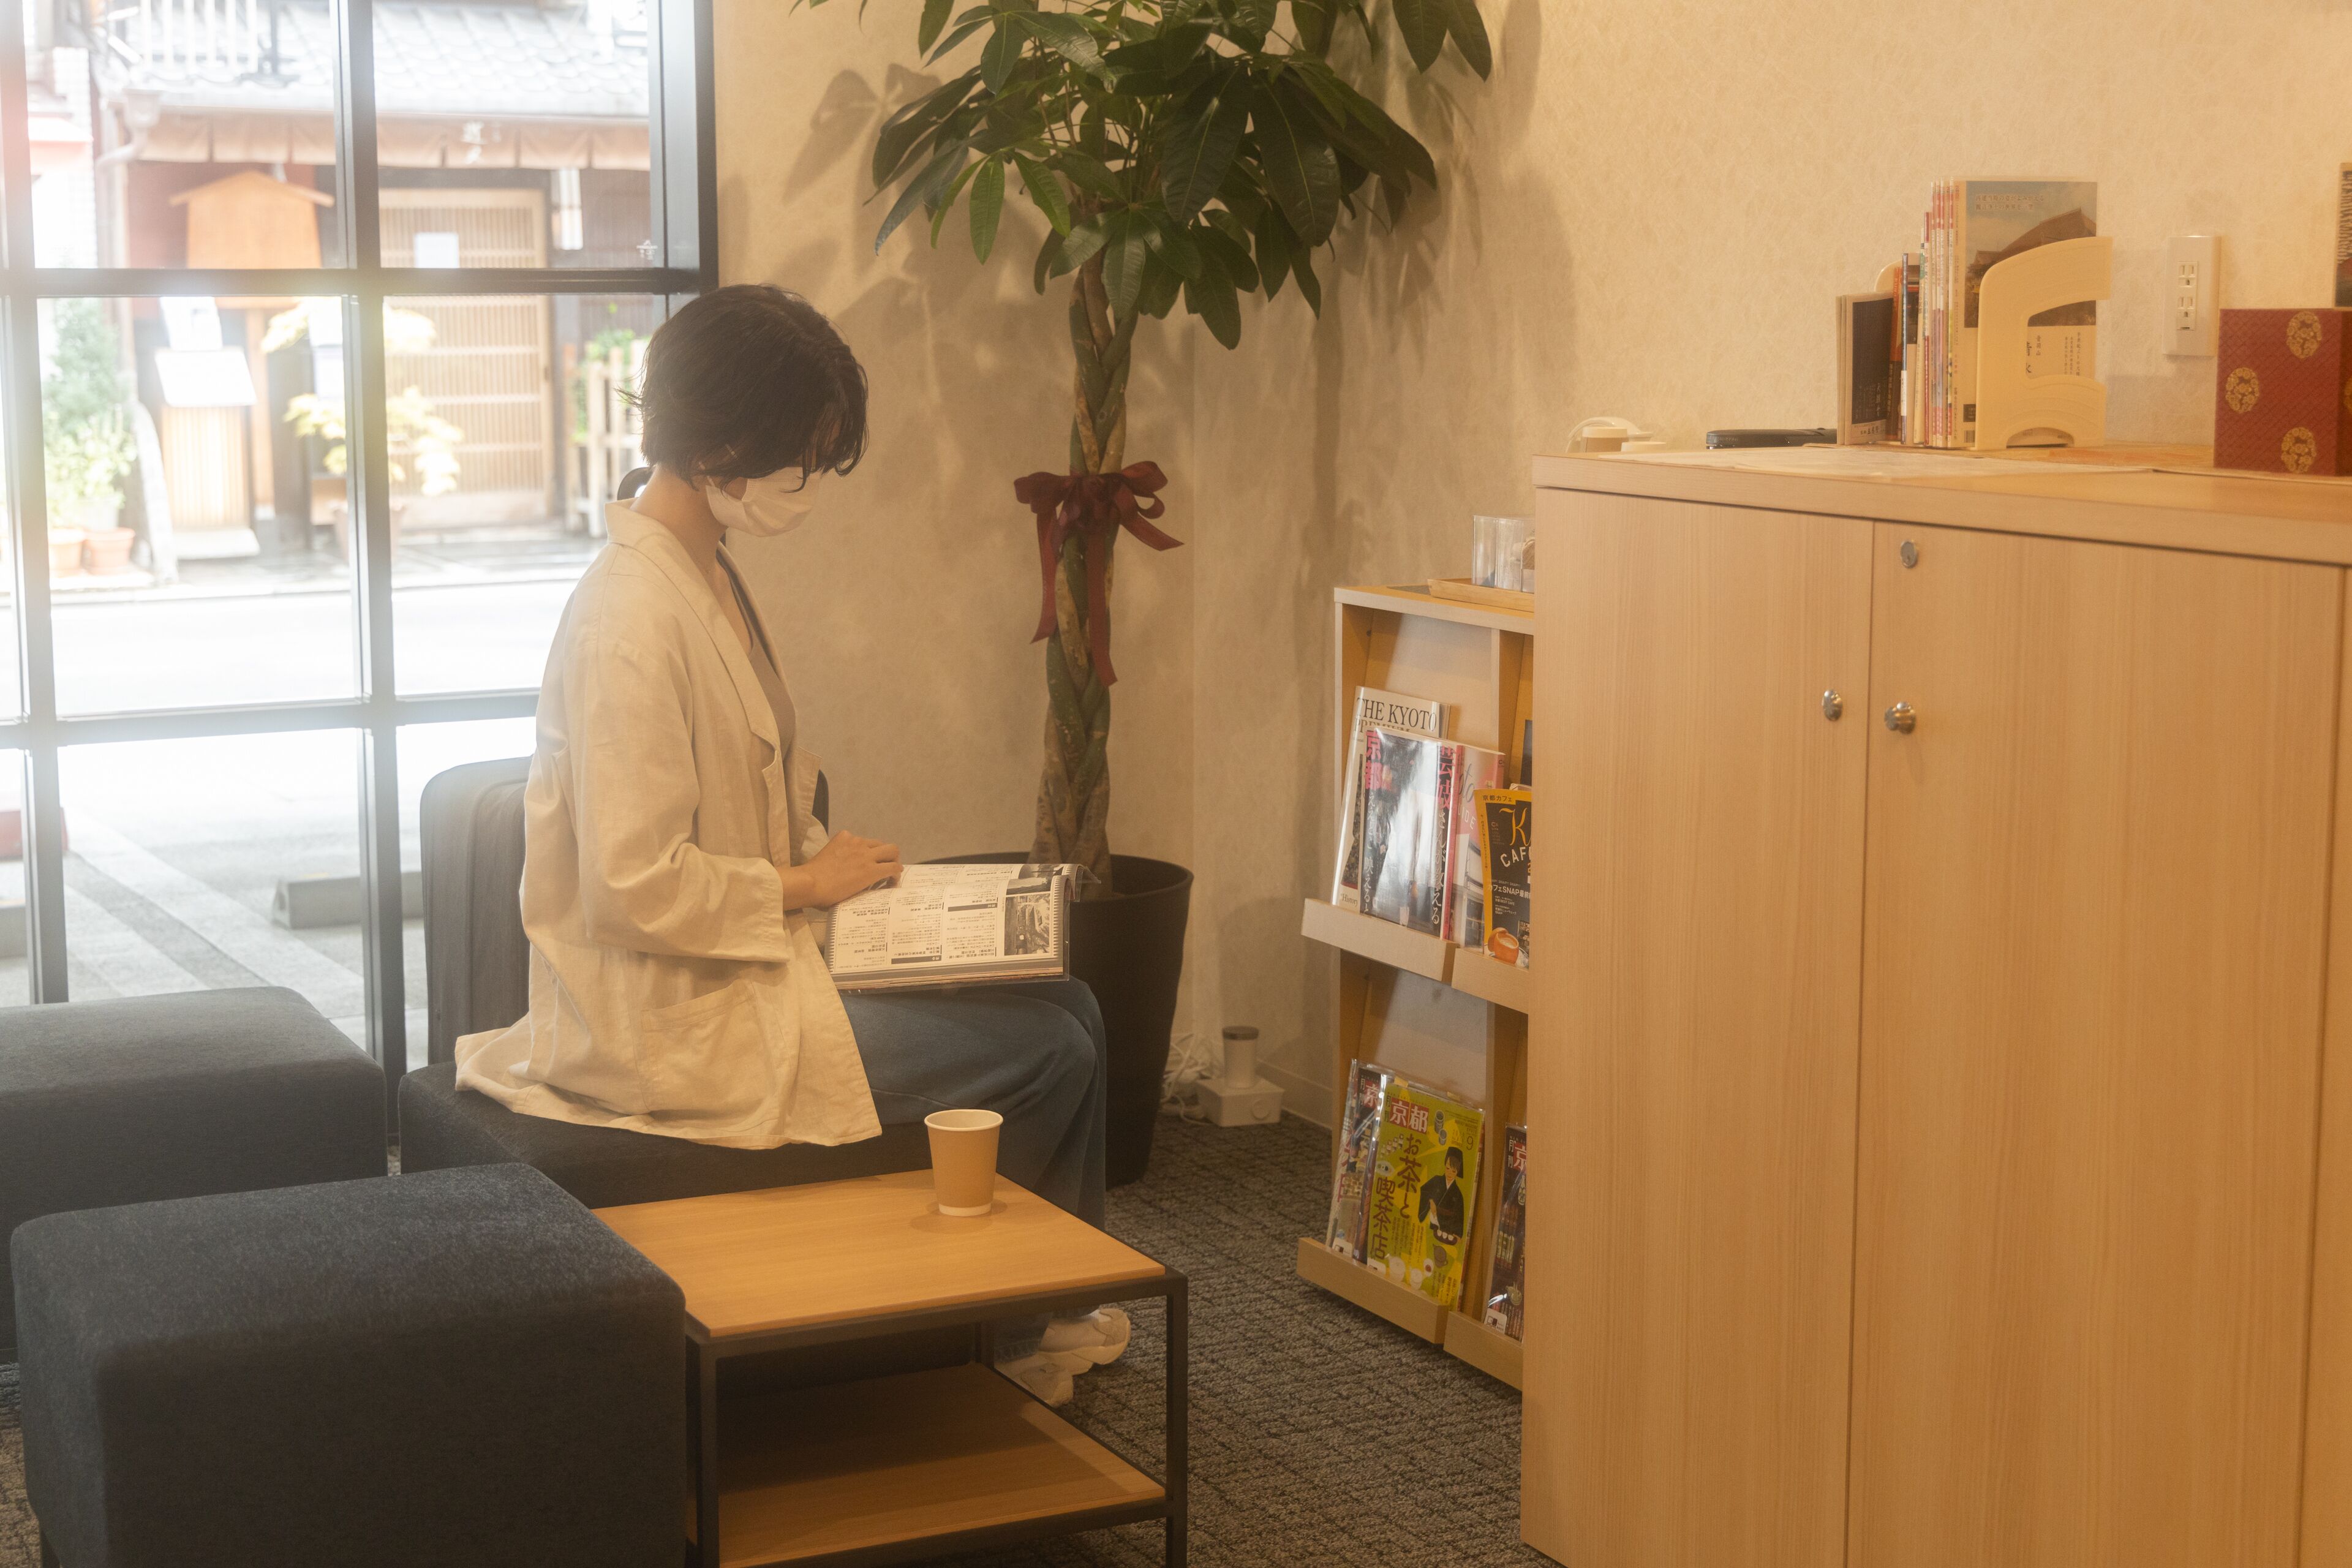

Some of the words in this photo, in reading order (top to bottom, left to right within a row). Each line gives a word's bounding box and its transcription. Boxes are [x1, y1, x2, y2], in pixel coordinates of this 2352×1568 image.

[1357, 697, 1384, 721] THE
[1387, 704, 1437, 732] KYOTO
[1390, 1100, 1428, 1133] 京都
[1466, 1136, 1474, 1151] 9
[1398, 1133, 1422, 1219] お茶と
[1370, 1177, 1395, 1261] 喫茶店
